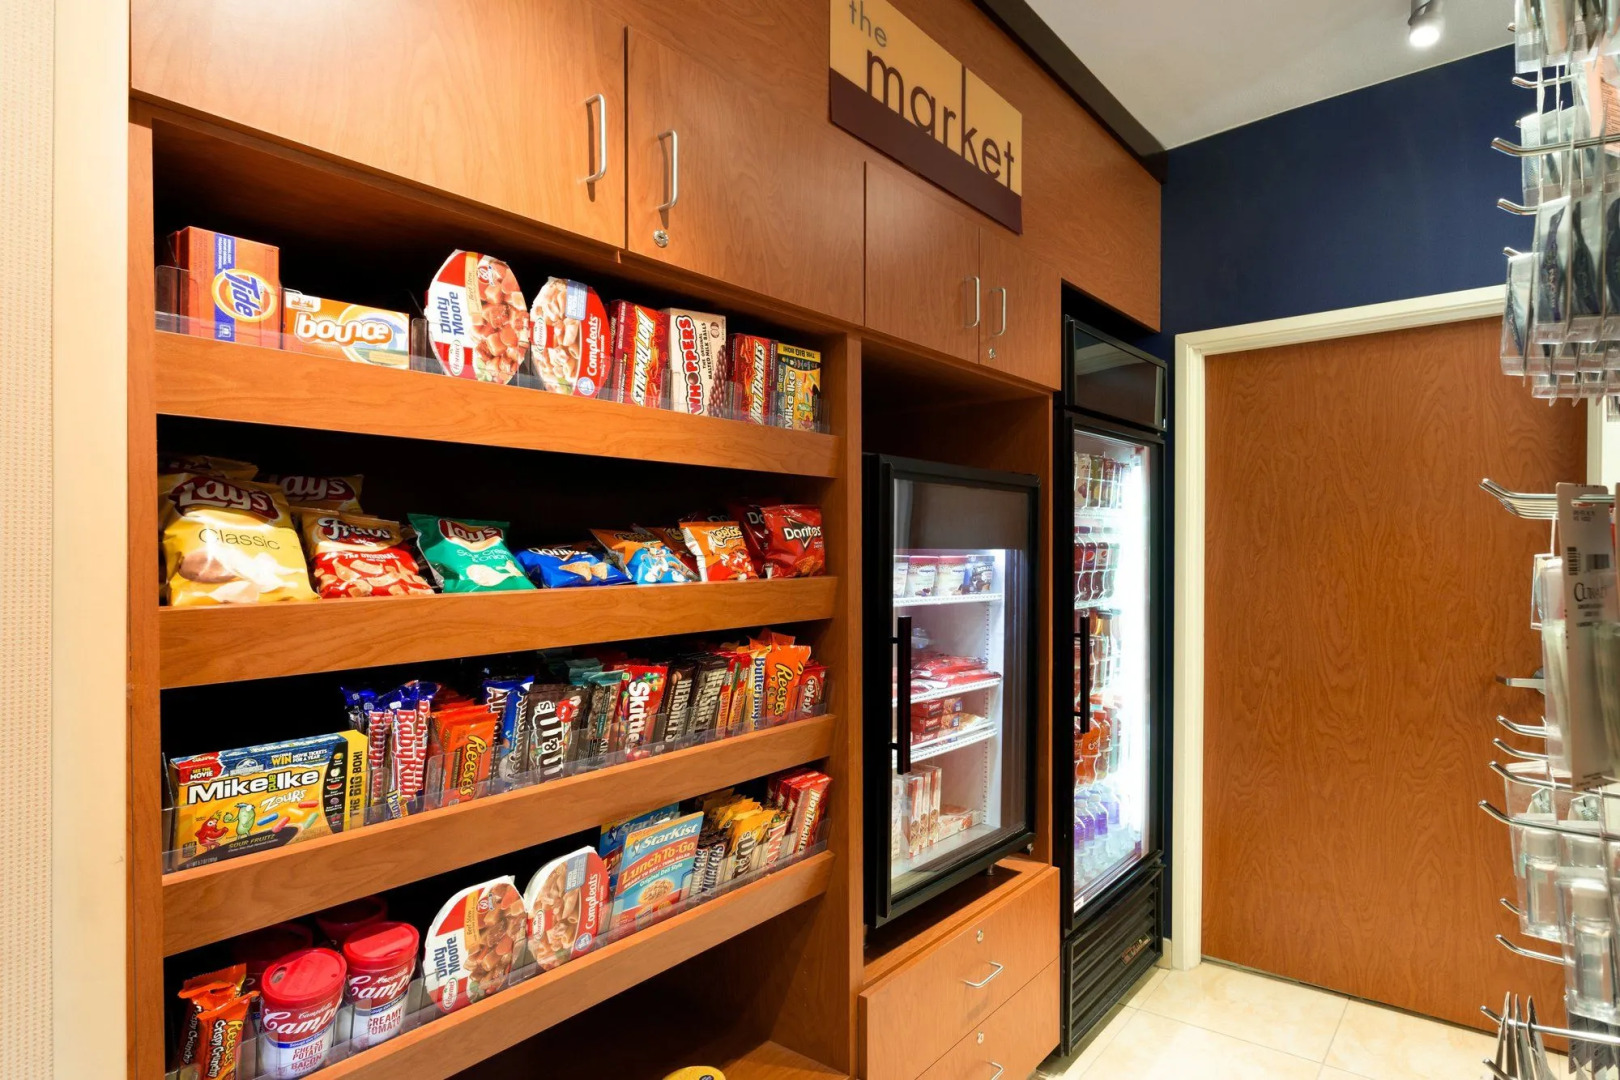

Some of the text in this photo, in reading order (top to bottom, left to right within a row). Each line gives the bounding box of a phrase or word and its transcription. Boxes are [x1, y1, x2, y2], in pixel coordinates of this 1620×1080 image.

[849, 0, 887, 47] the
[866, 49, 1014, 190] market
[224, 271, 260, 318] Tide
[296, 312, 392, 345] bounce
[437, 296, 451, 334] Dinty
[449, 292, 464, 336] Moore
[586, 315, 600, 377] Compleats
[678, 316, 702, 415] WHOPPERS
[750, 343, 765, 425] HOT TAMALES
[784, 370, 796, 430] Mike Ike
[198, 528, 280, 551] Classic
[317, 516, 392, 541] Fritos
[783, 526, 822, 541] Doritos
[752, 656, 767, 732] Butterfinger
[774, 662, 795, 717] Reese's
[190, 770, 213, 780] MOVIE
[271, 755, 292, 767] WIN
[352, 750, 363, 774] BOX!
[459, 734, 487, 797] Reese's
[188, 778, 269, 805] Mike
[268, 774, 278, 792] and
[276, 770, 319, 790] Ike
[260, 789, 306, 813] ZOURS
[641, 823, 698, 849] StarKist
[622, 854, 661, 885] Lunch
[639, 873, 660, 887] Original
[660, 867, 671, 876] Deli
[585, 872, 599, 930] Compleats
[434, 945, 447, 980] Dinty
[448, 936, 461, 976] Moore
[367, 1007, 404, 1027] CREAMY
[182, 1027, 199, 1064] Crunchy
[207, 1019, 227, 1079] Crispy Crunchy
[290, 1054, 323, 1071] BACON
[292, 1045, 324, 1061] POTATO
[293, 1040, 325, 1054] CHEESY
